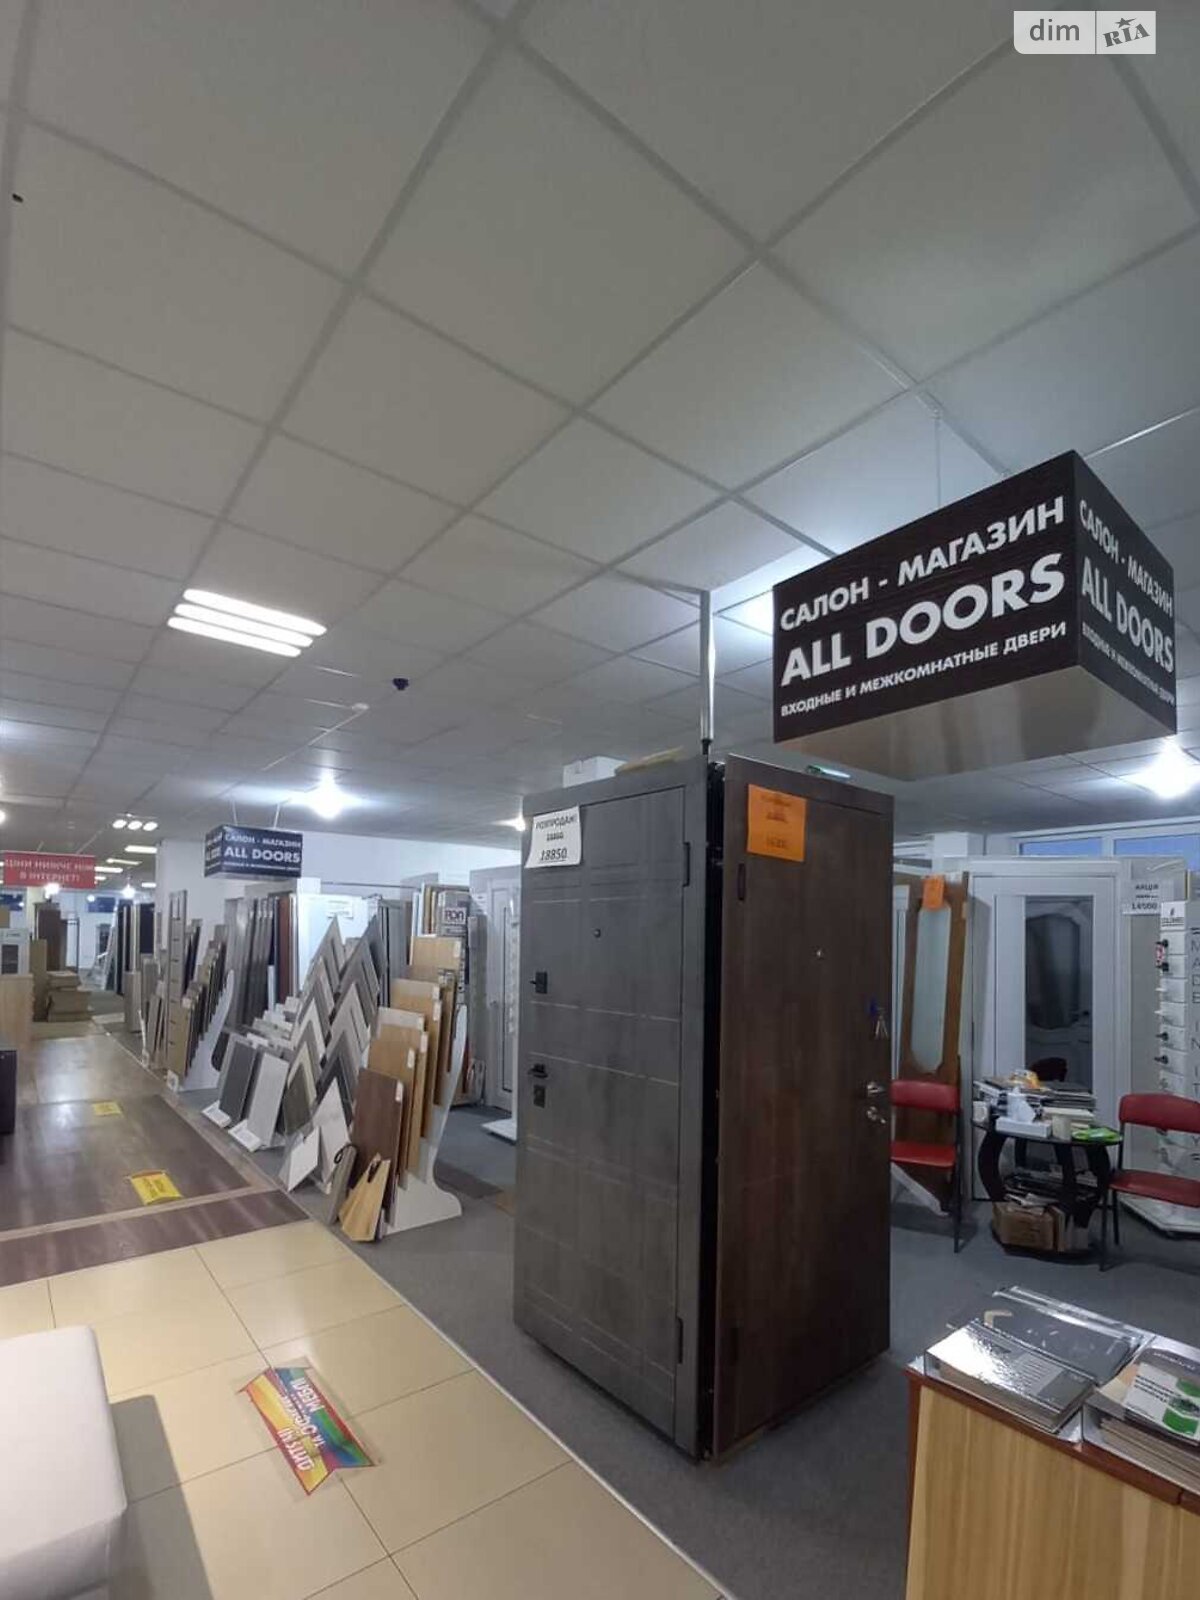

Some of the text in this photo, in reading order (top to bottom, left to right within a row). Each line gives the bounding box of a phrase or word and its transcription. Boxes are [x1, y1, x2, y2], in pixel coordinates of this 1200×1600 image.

[780, 577, 869, 631] САЛОН
[896, 495, 1065, 587] МАГАЗИН
[1079, 499, 1119, 563] САЛОН
[1127, 559, 1174, 619] МАГАЗИН
[780, 552, 1066, 687] ALL DOORS
[1080, 558, 1112, 623] ALL
[1116, 601, 1175, 674] DOORS
[780, 621, 1067, 718] ВХОДНЫЕ И МЕЖКОМНАТНЫЕ ДВЕРИ
[224, 846, 300, 863] ALL DOORS
[225, 834, 255, 844] САЛОН
[262, 838, 301, 847] МАГАЗИН
[540, 847, 568, 861] 18850
